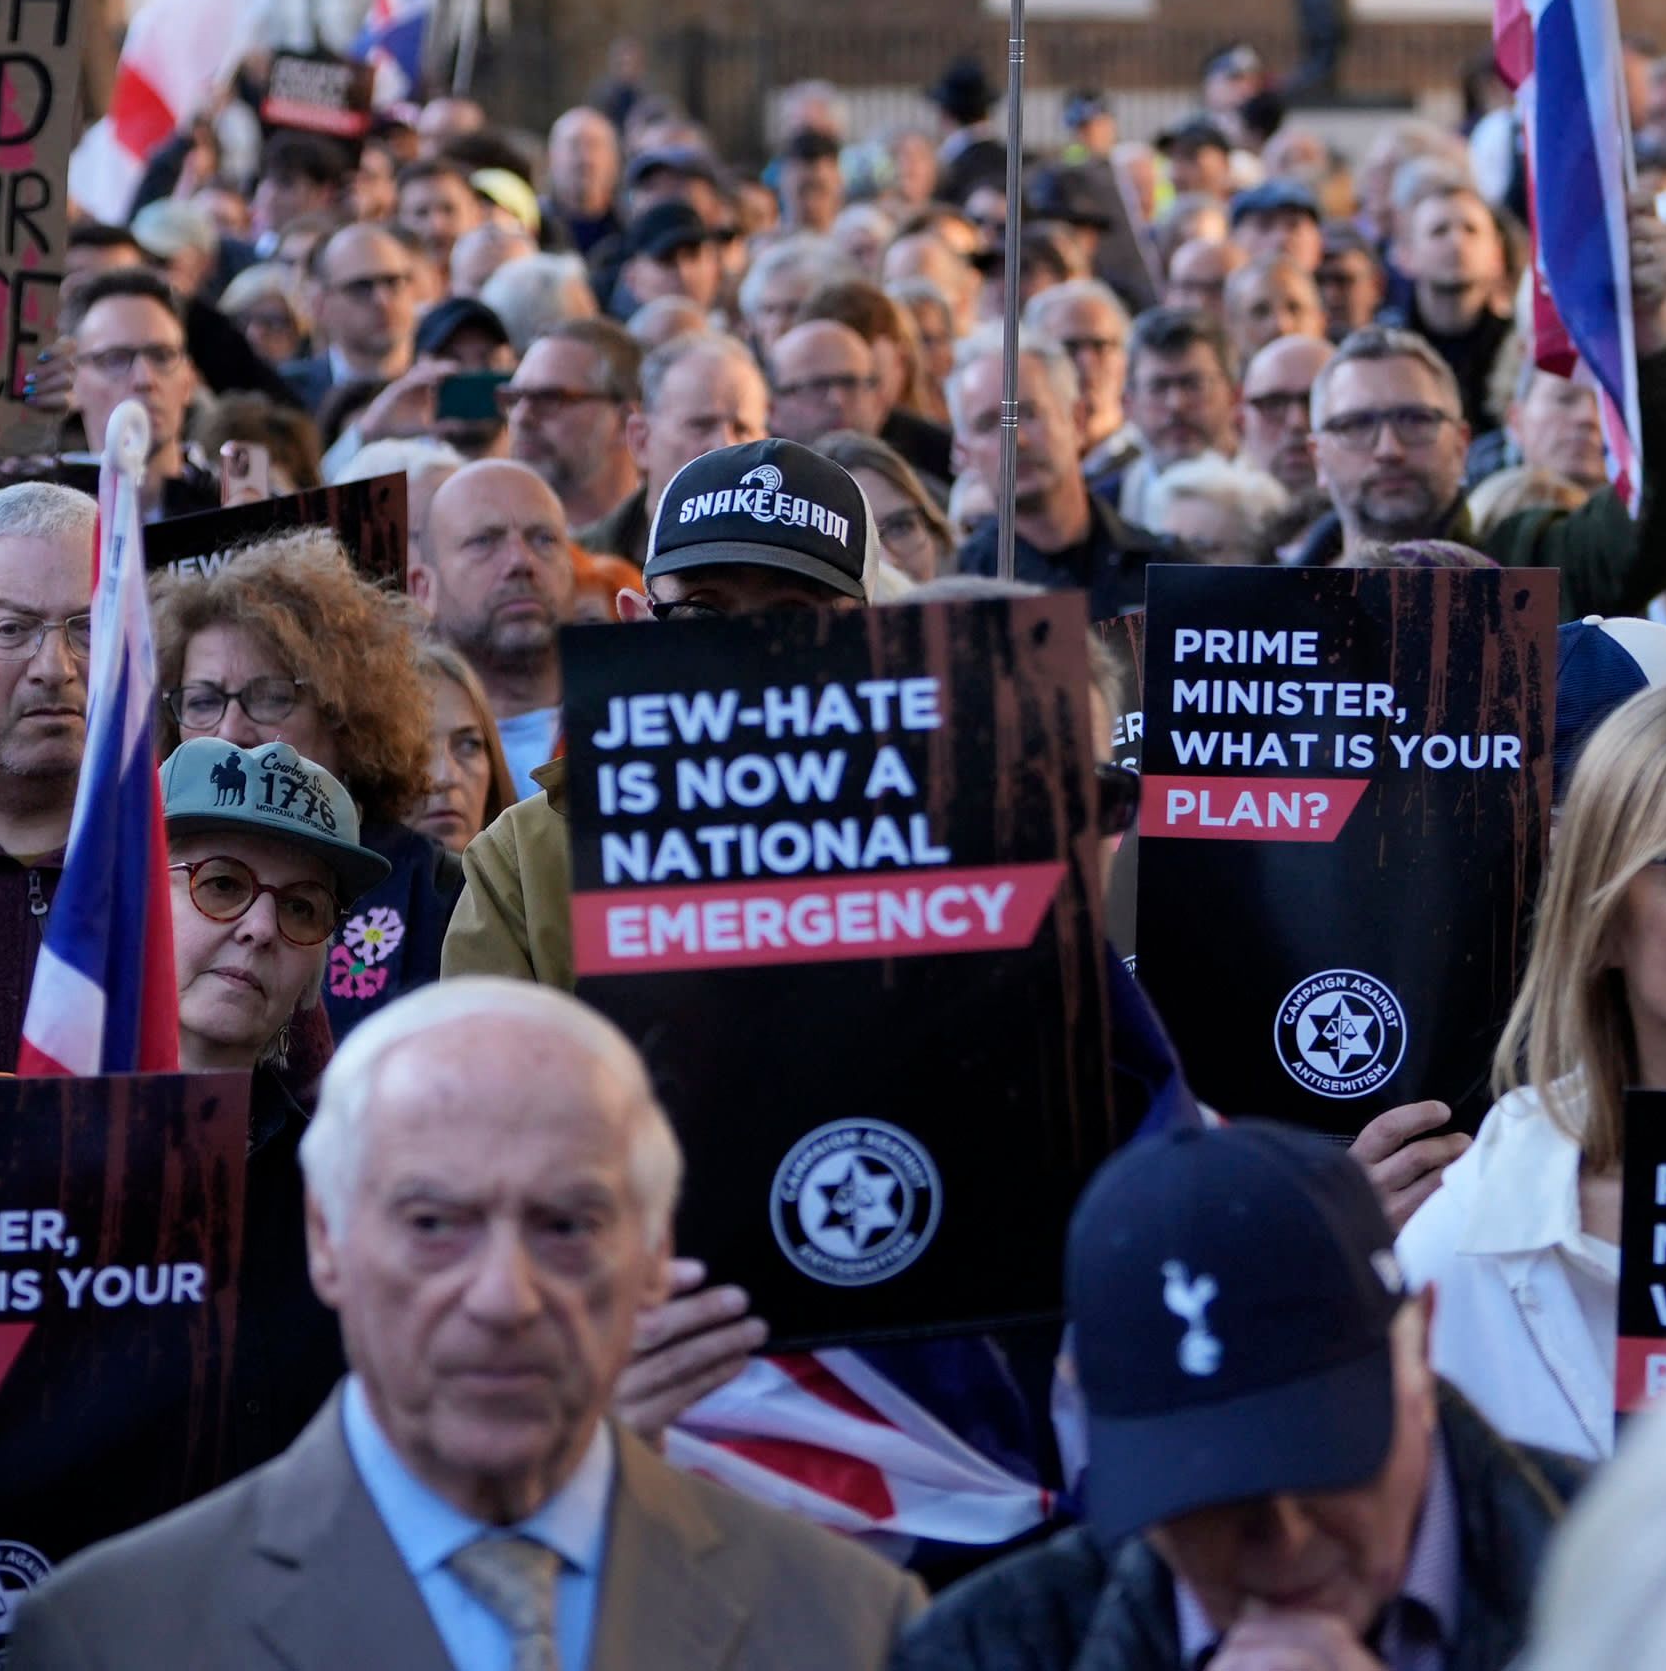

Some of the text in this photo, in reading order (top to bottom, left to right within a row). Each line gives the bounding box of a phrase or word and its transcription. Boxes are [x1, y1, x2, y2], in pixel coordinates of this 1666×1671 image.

[1173, 628, 1319, 666] PRIME
[591, 676, 942, 750] JEW-HATE
[1171, 679, 1408, 725] MINISTER,
[261, 752, 310, 788] Cowboy
[1170, 730, 1320, 768] WHAT
[1334, 734, 1375, 769] IS
[1389, 734, 1522, 770] YOUR
[259, 771, 337, 831] 1776
[597, 744, 916, 816] IS NOW A
[1165, 788, 1329, 828] PLAN?
[601, 812, 951, 885] NATIONAL
[606, 880, 1016, 960] EMERGENCY
[1284, 977, 1399, 1028] CAMPAIGN AGAINST
[1291, 1061, 1387, 1092] ANTISEMITISM
[57, 1262, 206, 1310] YOUR
